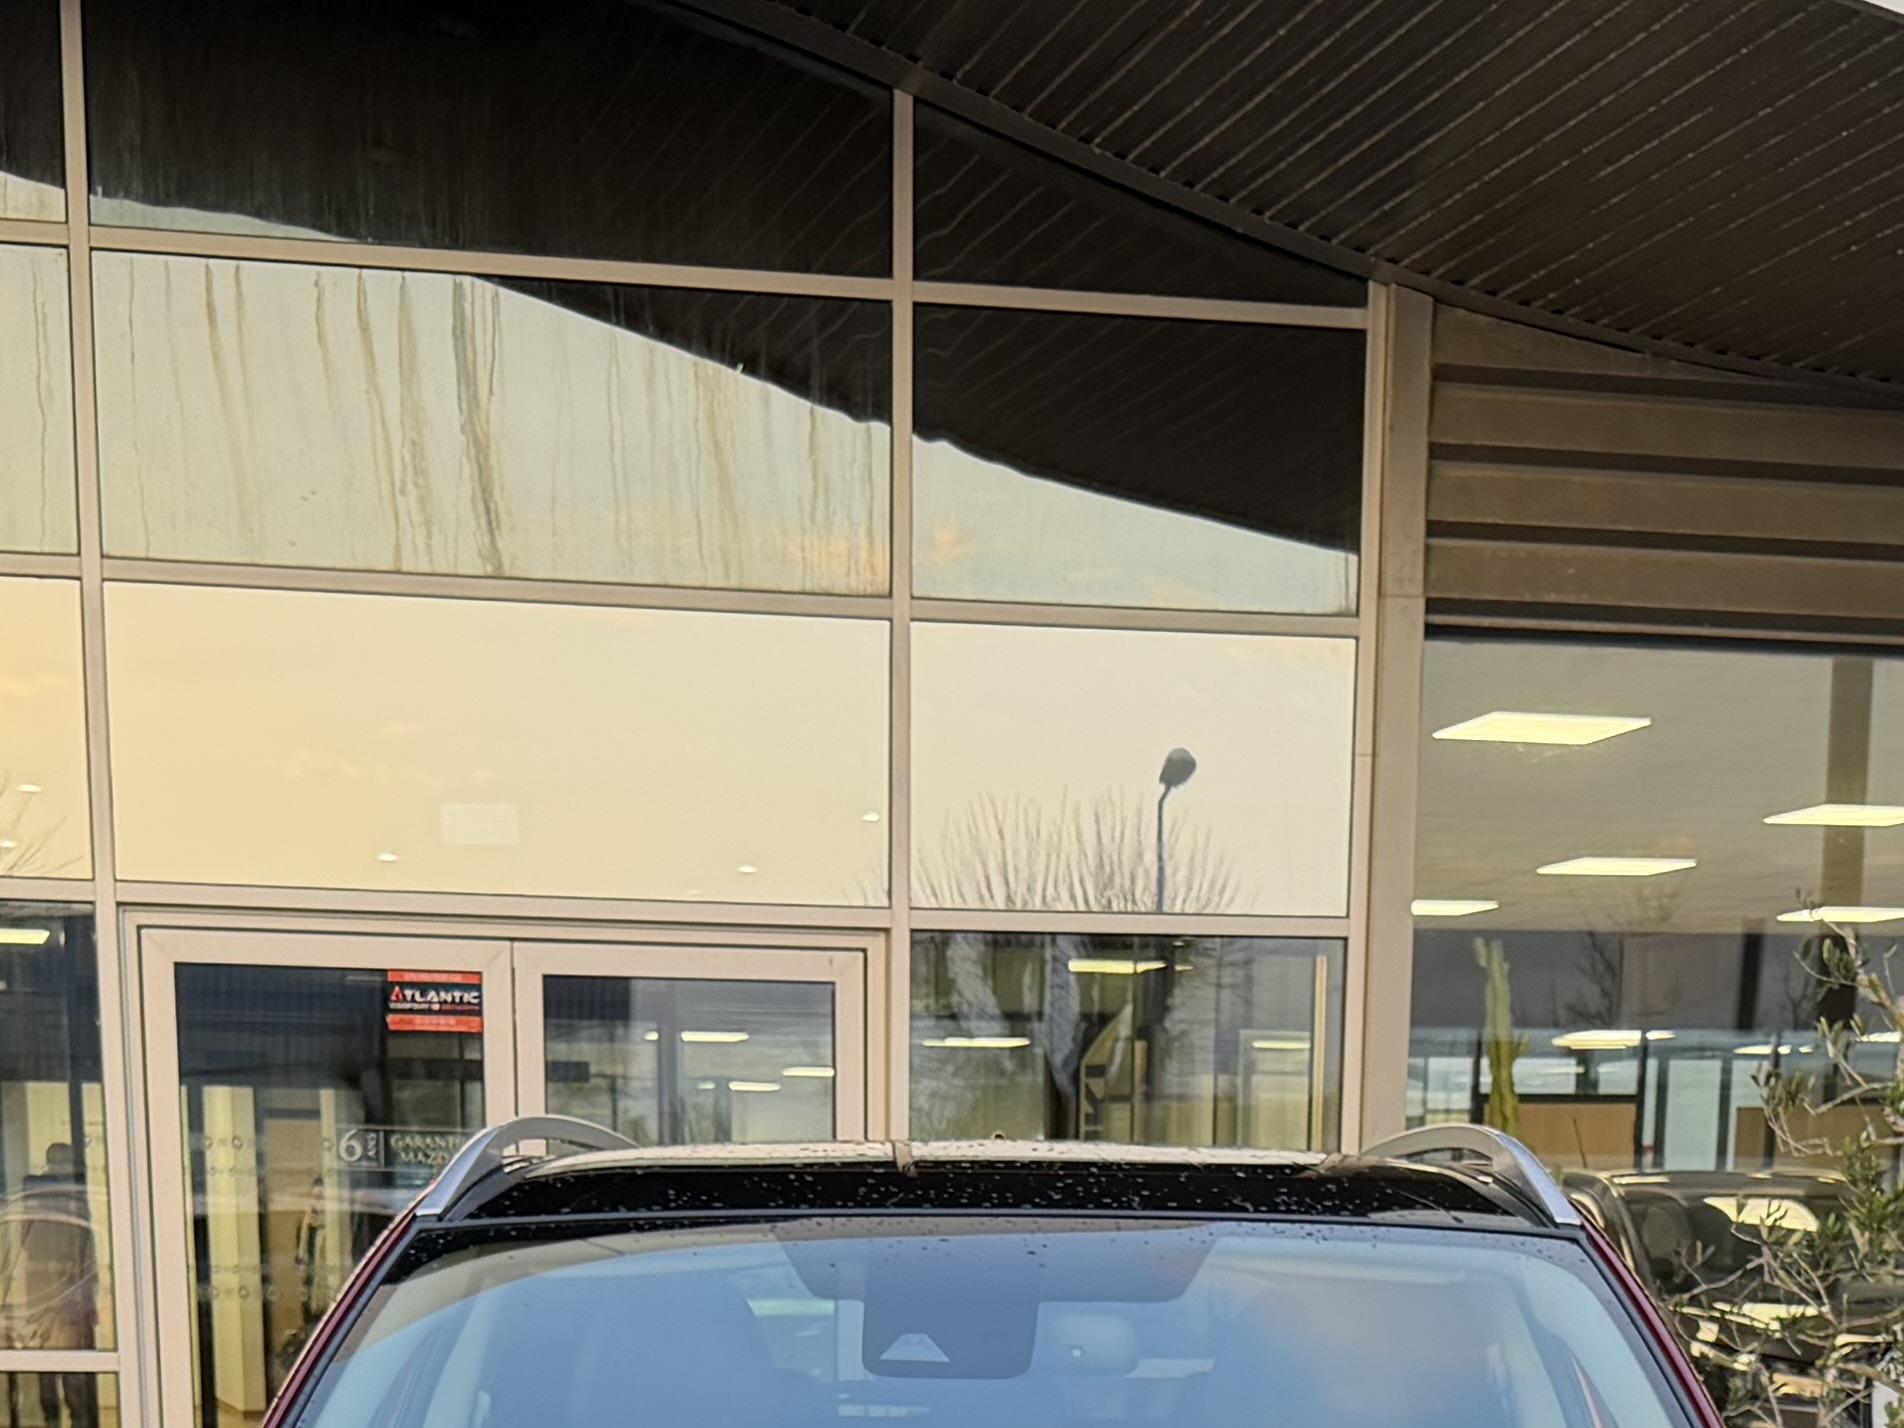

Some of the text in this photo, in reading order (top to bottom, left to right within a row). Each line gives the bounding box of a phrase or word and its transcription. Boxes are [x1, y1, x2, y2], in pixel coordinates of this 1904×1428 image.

[391, 986, 480, 1004] ATLANTIC
[338, 1129, 364, 1162] 6
[399, 1149, 450, 1165] MAZD
